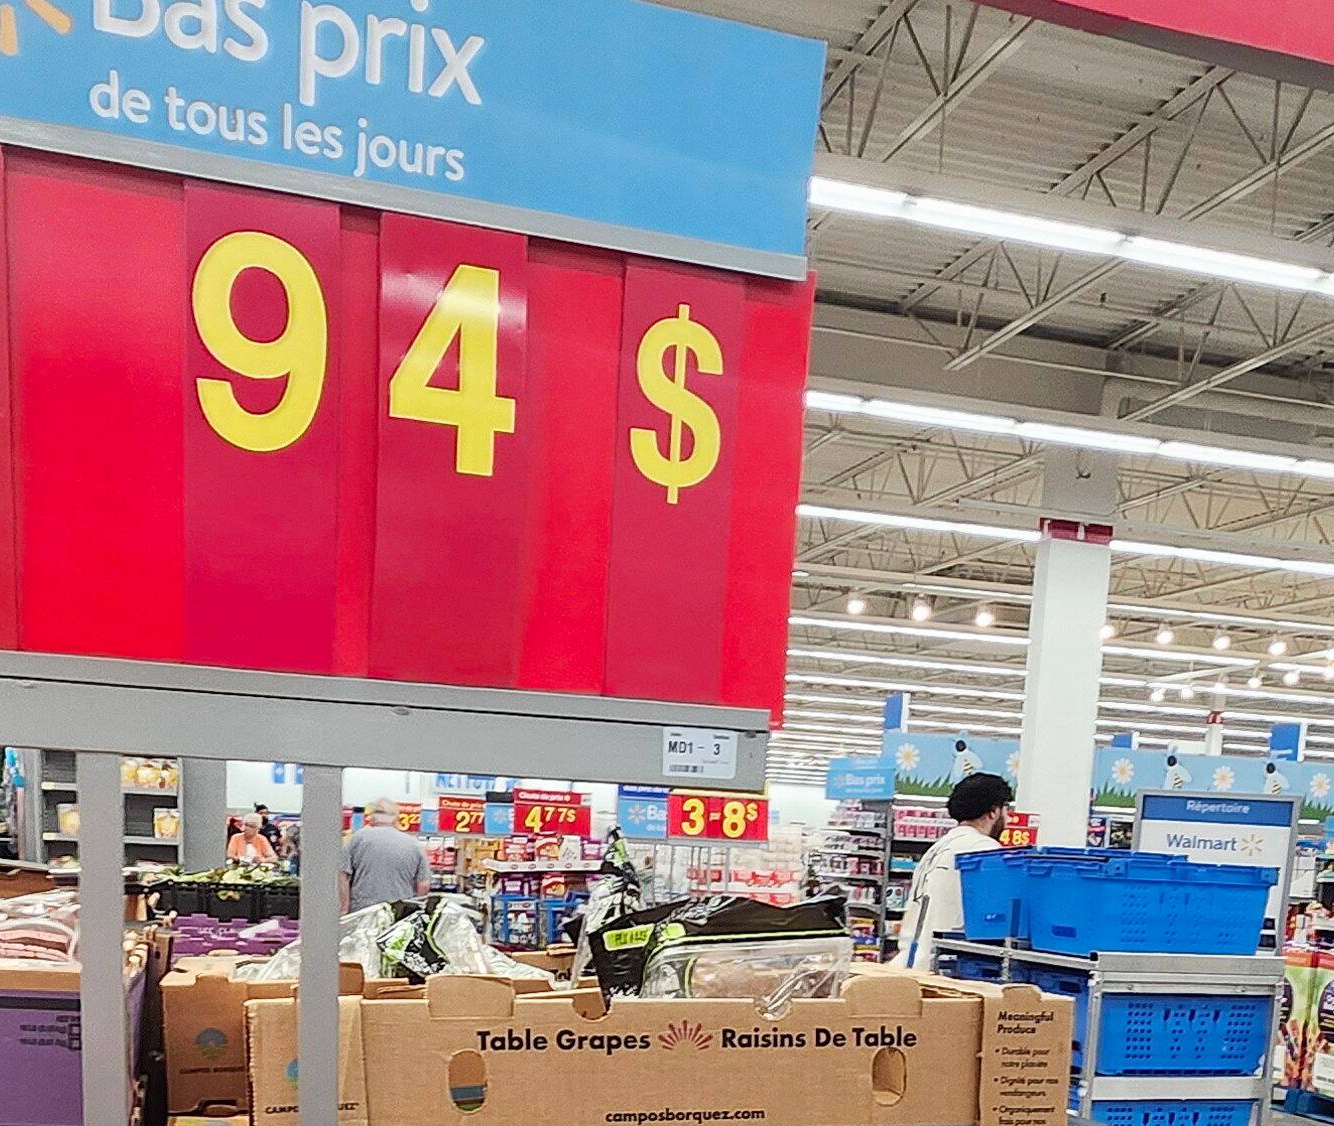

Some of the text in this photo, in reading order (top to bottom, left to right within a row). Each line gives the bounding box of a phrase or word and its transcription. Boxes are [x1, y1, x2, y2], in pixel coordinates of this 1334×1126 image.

[299, 0, 485, 106] prix
[89, 71, 465, 181] de tous les jours
[668, 741, 694, 754] MD1
[713, 743, 721, 756] 3
[1186, 800, 1251, 814] Répertoire
[1166, 833, 1237, 851] Walmart
[998, 1011, 1054, 1024] Meaningful
[721, 1026, 918, 1049] Raisins De Table
[997, 1024, 1036, 1035] Produce
[476, 1029, 651, 1055] Table Grapes
[605, 1107, 765, 1125] camposborquez.com
